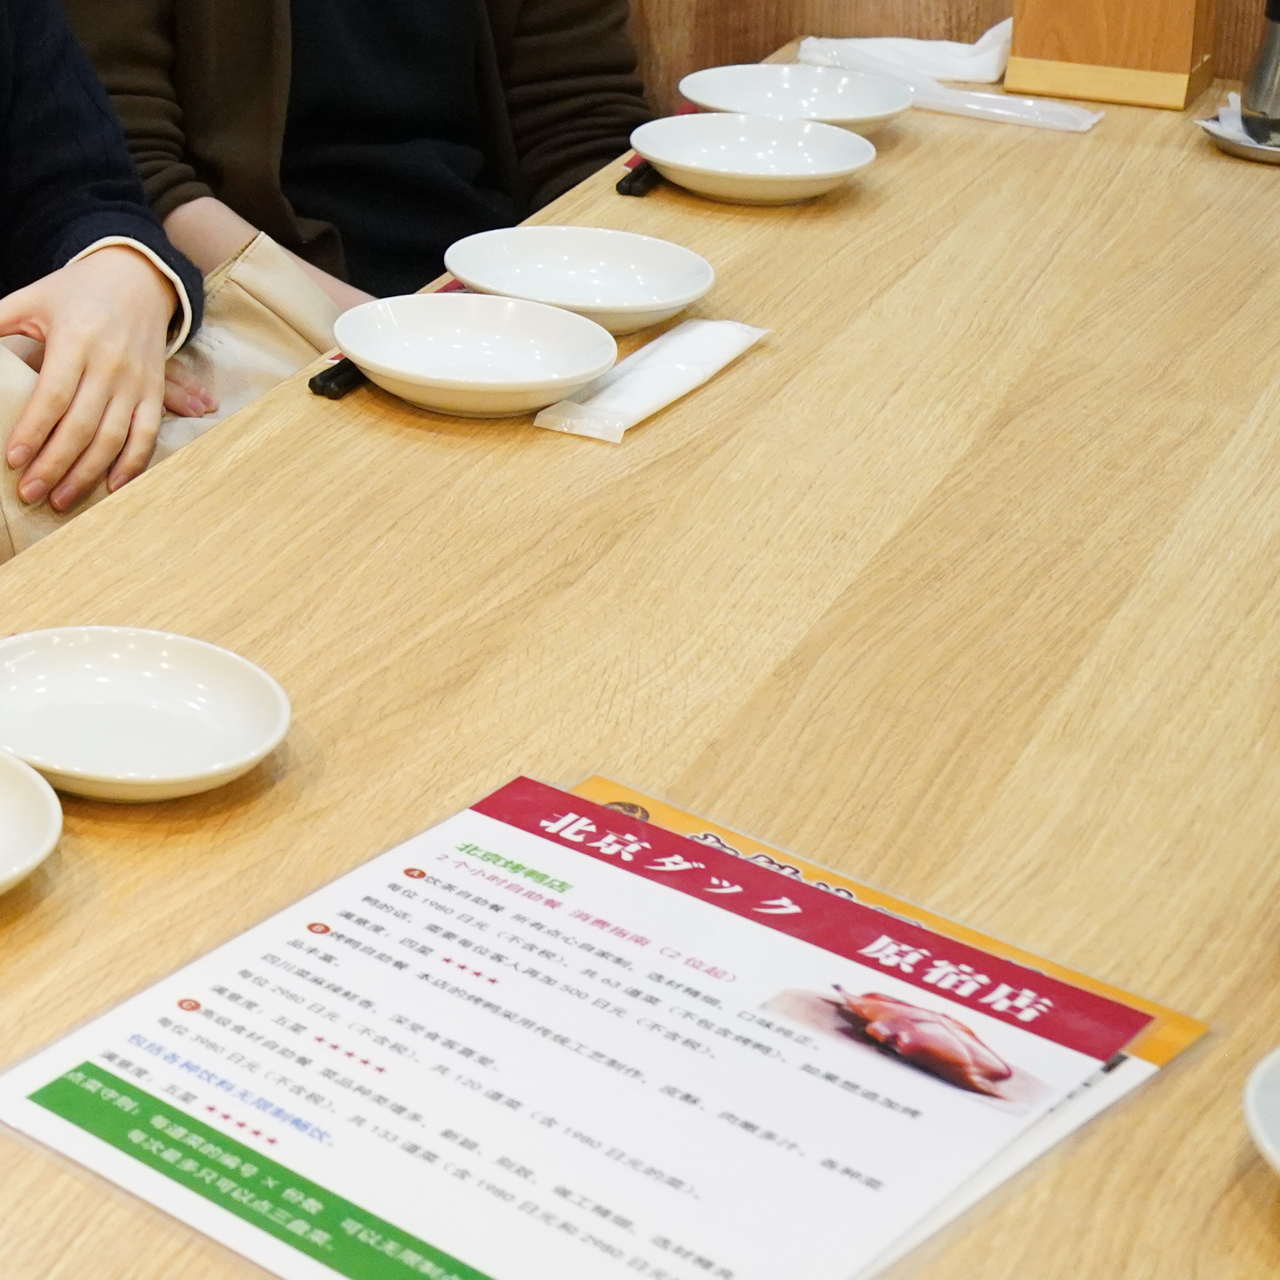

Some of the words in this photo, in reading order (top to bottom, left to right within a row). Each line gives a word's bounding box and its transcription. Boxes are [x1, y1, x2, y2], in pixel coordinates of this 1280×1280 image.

[454, 860, 564, 910] 个小时自助餐
[455, 843, 573, 894] 北京烤鸭店
[539, 812, 802, 914] 北京ダック
[858, 934, 1053, 1022] 原宿店
